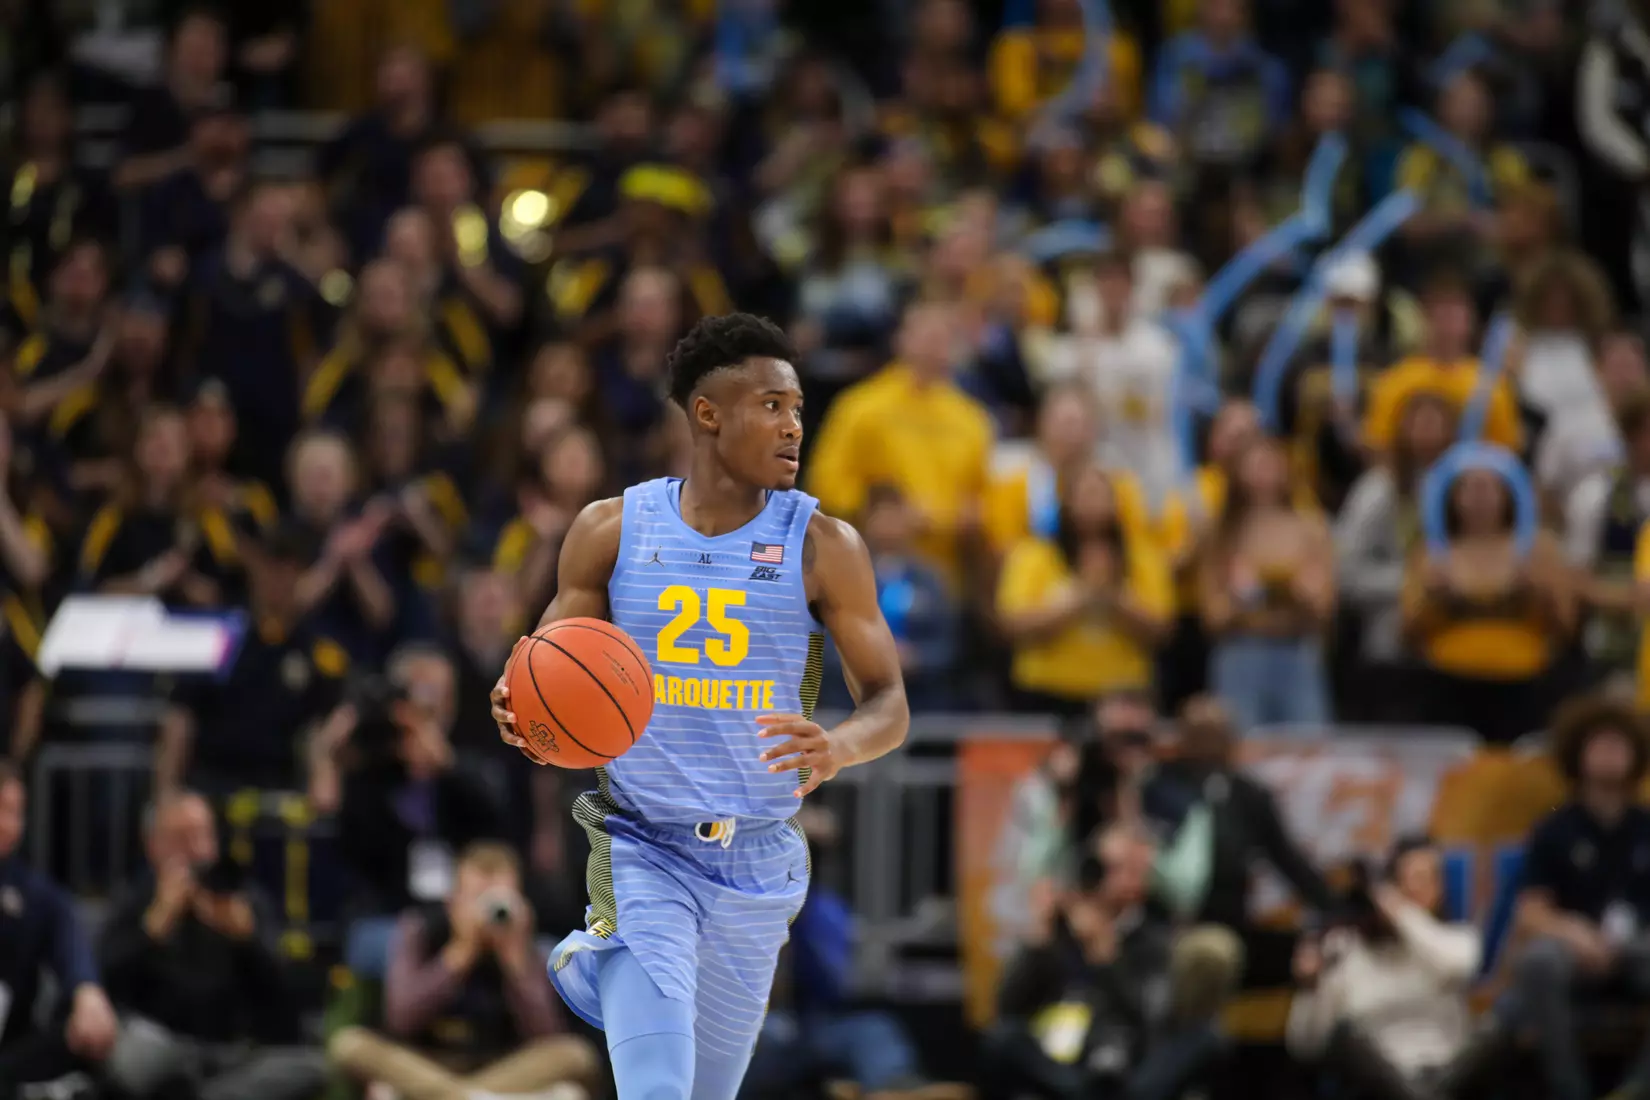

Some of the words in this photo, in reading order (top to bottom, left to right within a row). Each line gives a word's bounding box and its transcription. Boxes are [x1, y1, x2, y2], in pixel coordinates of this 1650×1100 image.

[749, 573, 782, 581] EAST
[755, 565, 776, 573] BIG
[657, 585, 750, 667] 25
[654, 673, 775, 709] ARQUETTE
